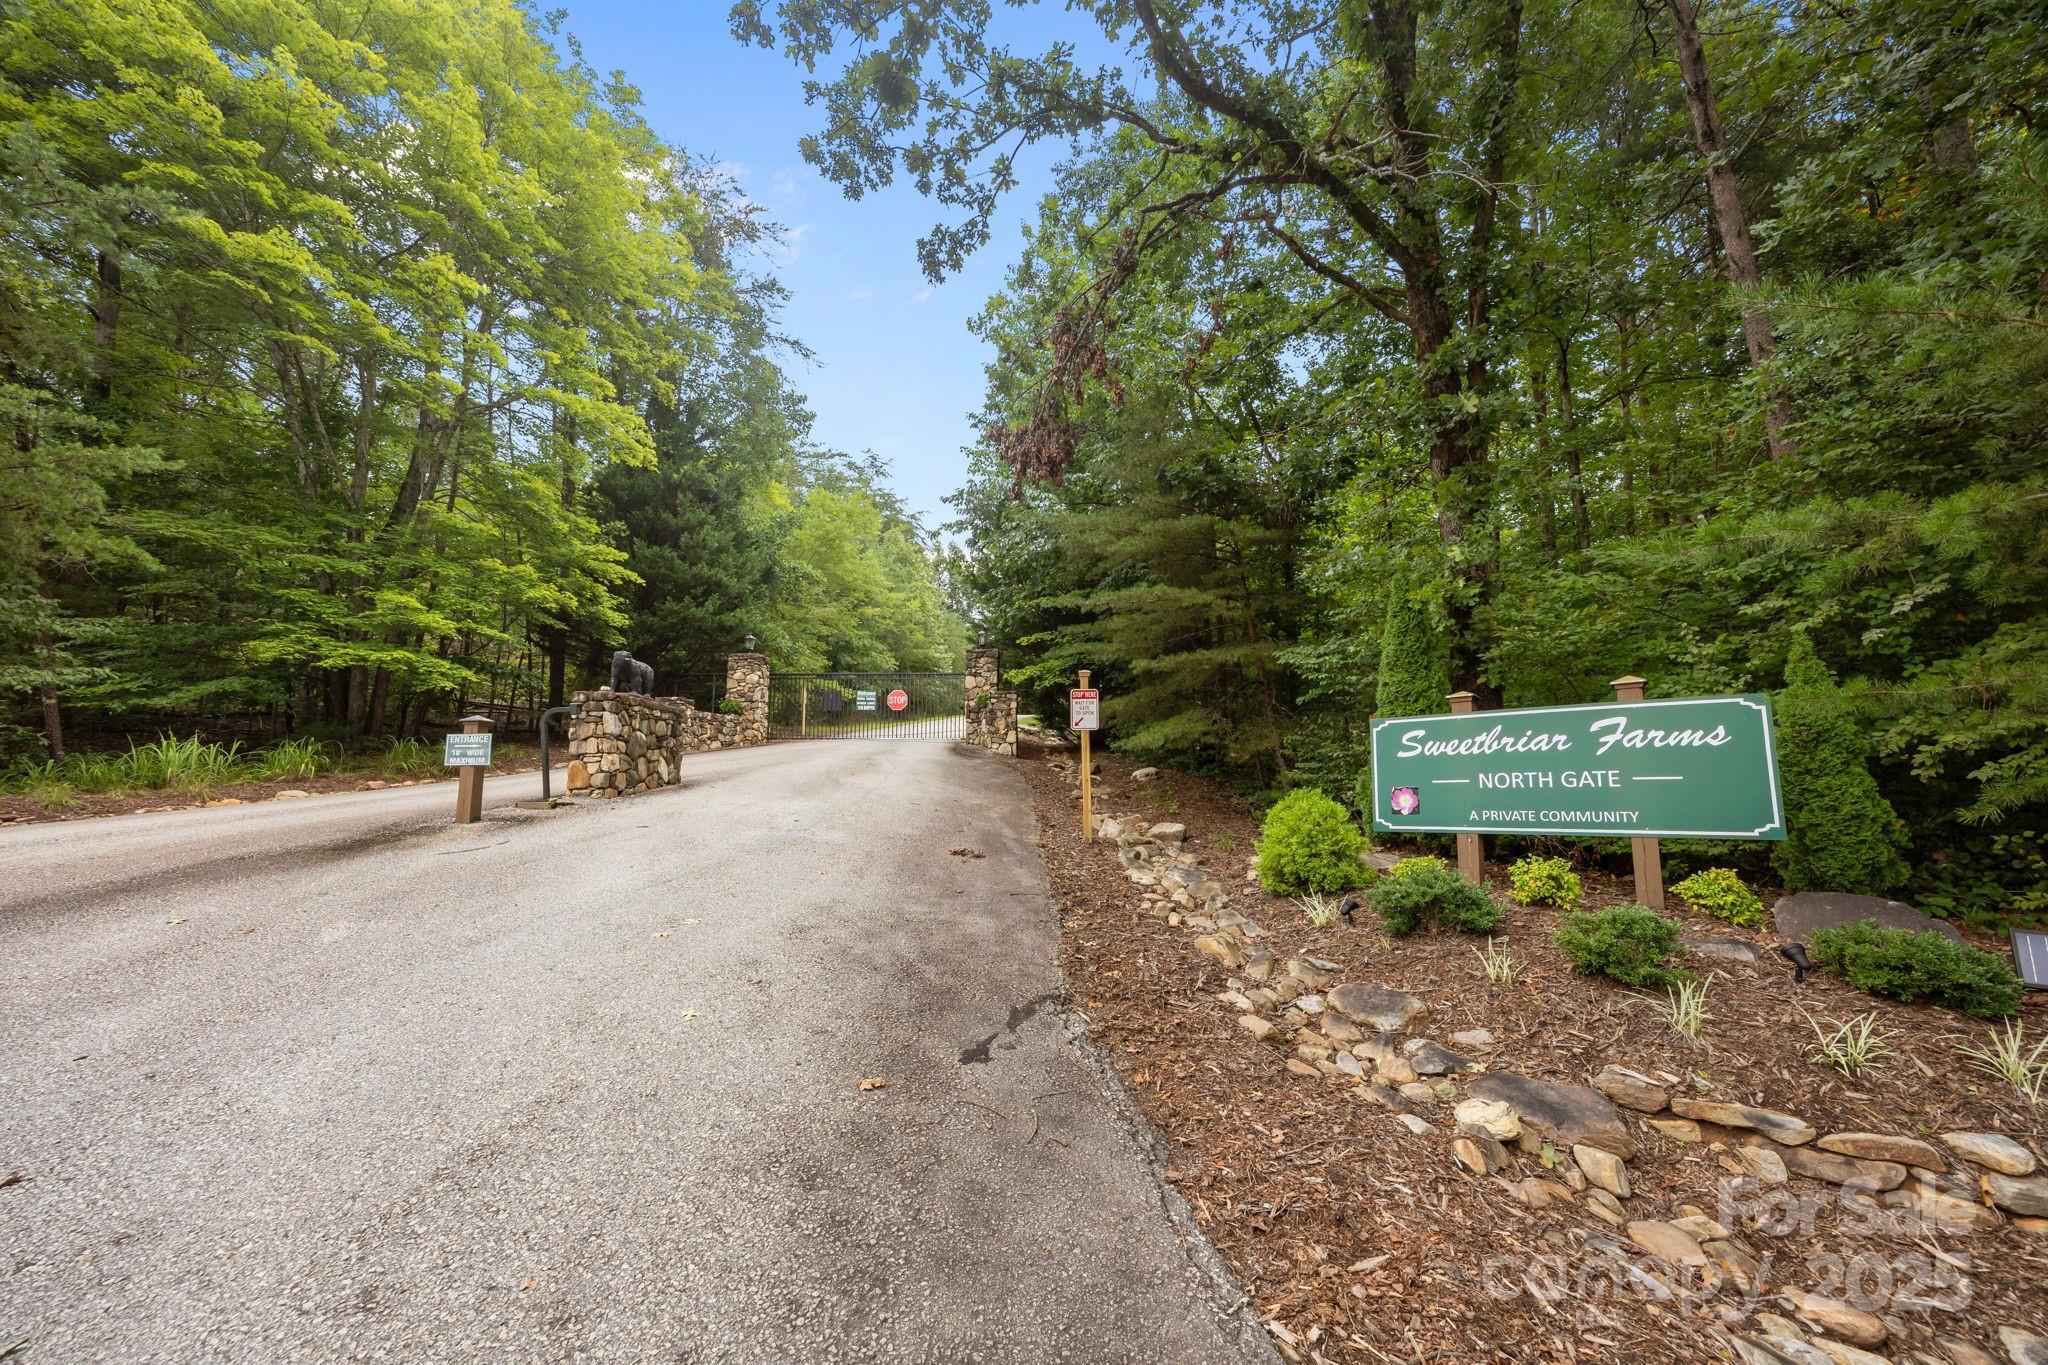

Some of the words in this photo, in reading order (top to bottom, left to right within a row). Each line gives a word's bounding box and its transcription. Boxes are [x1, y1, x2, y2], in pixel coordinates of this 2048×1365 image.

[889, 696, 907, 704] STOP
[450, 735, 488, 743] ENTRANCE
[1397, 725, 1572, 757] Sweetbriar
[1590, 716, 1732, 756] Farms
[1478, 772, 1553, 789] NORTH
[1561, 770, 1621, 787] GATE
[1469, 811, 1479, 820] A
[1482, 811, 1536, 821] PRIVATE
[1540, 811, 1639, 823] COMMUNITY
